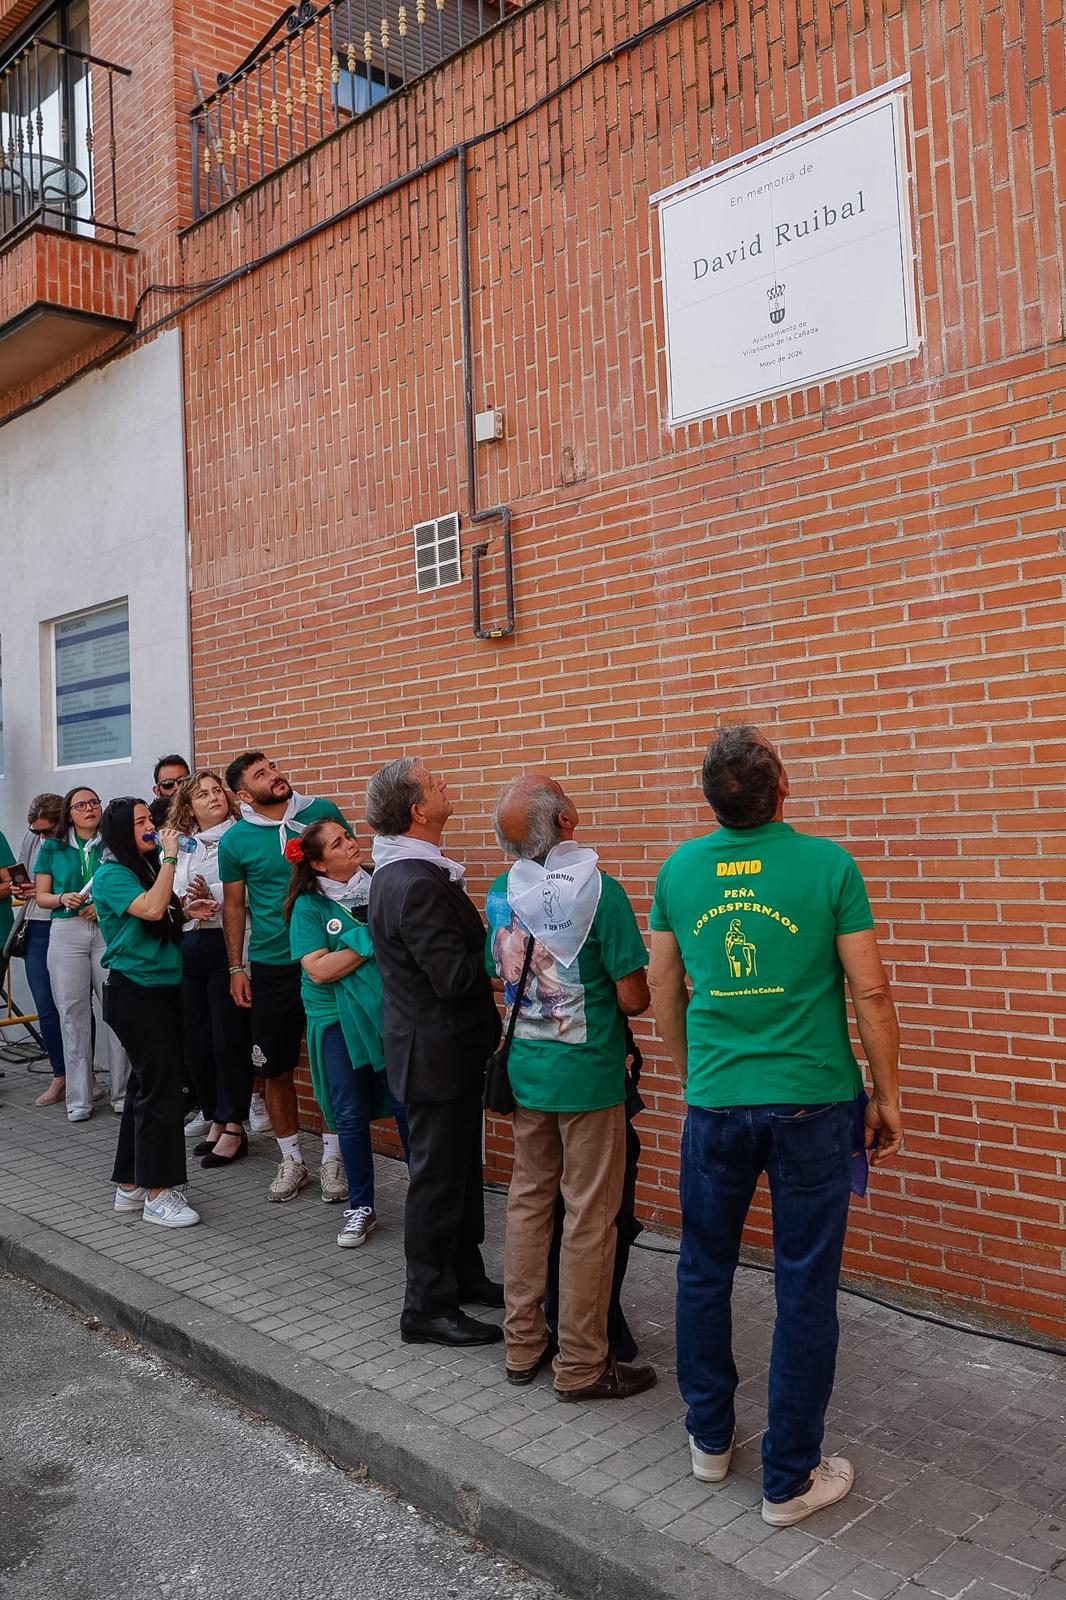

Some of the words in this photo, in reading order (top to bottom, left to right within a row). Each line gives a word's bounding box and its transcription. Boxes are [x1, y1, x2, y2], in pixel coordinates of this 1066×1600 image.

[729, 197, 743, 208] En
[747, 173, 796, 200] memoria
[799, 163, 814, 176] de
[692, 233, 763, 281] David
[774, 190, 866, 247] Ruibal
[752, 324, 797, 345] Ayuntamiento
[742, 342, 775, 357] Villanueva
[759, 358, 776, 368] Mayo
[777, 355, 786, 363] de
[787, 349, 804, 360] 2026
[717, 860, 762, 876] DAVID
[546, 874, 575, 882] DORMIR
[723, 887, 755, 898] PEÑA
[558, 920, 573, 930] FELIZ
[692, 913, 709, 936] LOS
[708, 901, 799, 934] DESPERNAOS
[751, 987, 759, 995] la
[759, 986, 785, 994] Cañada
